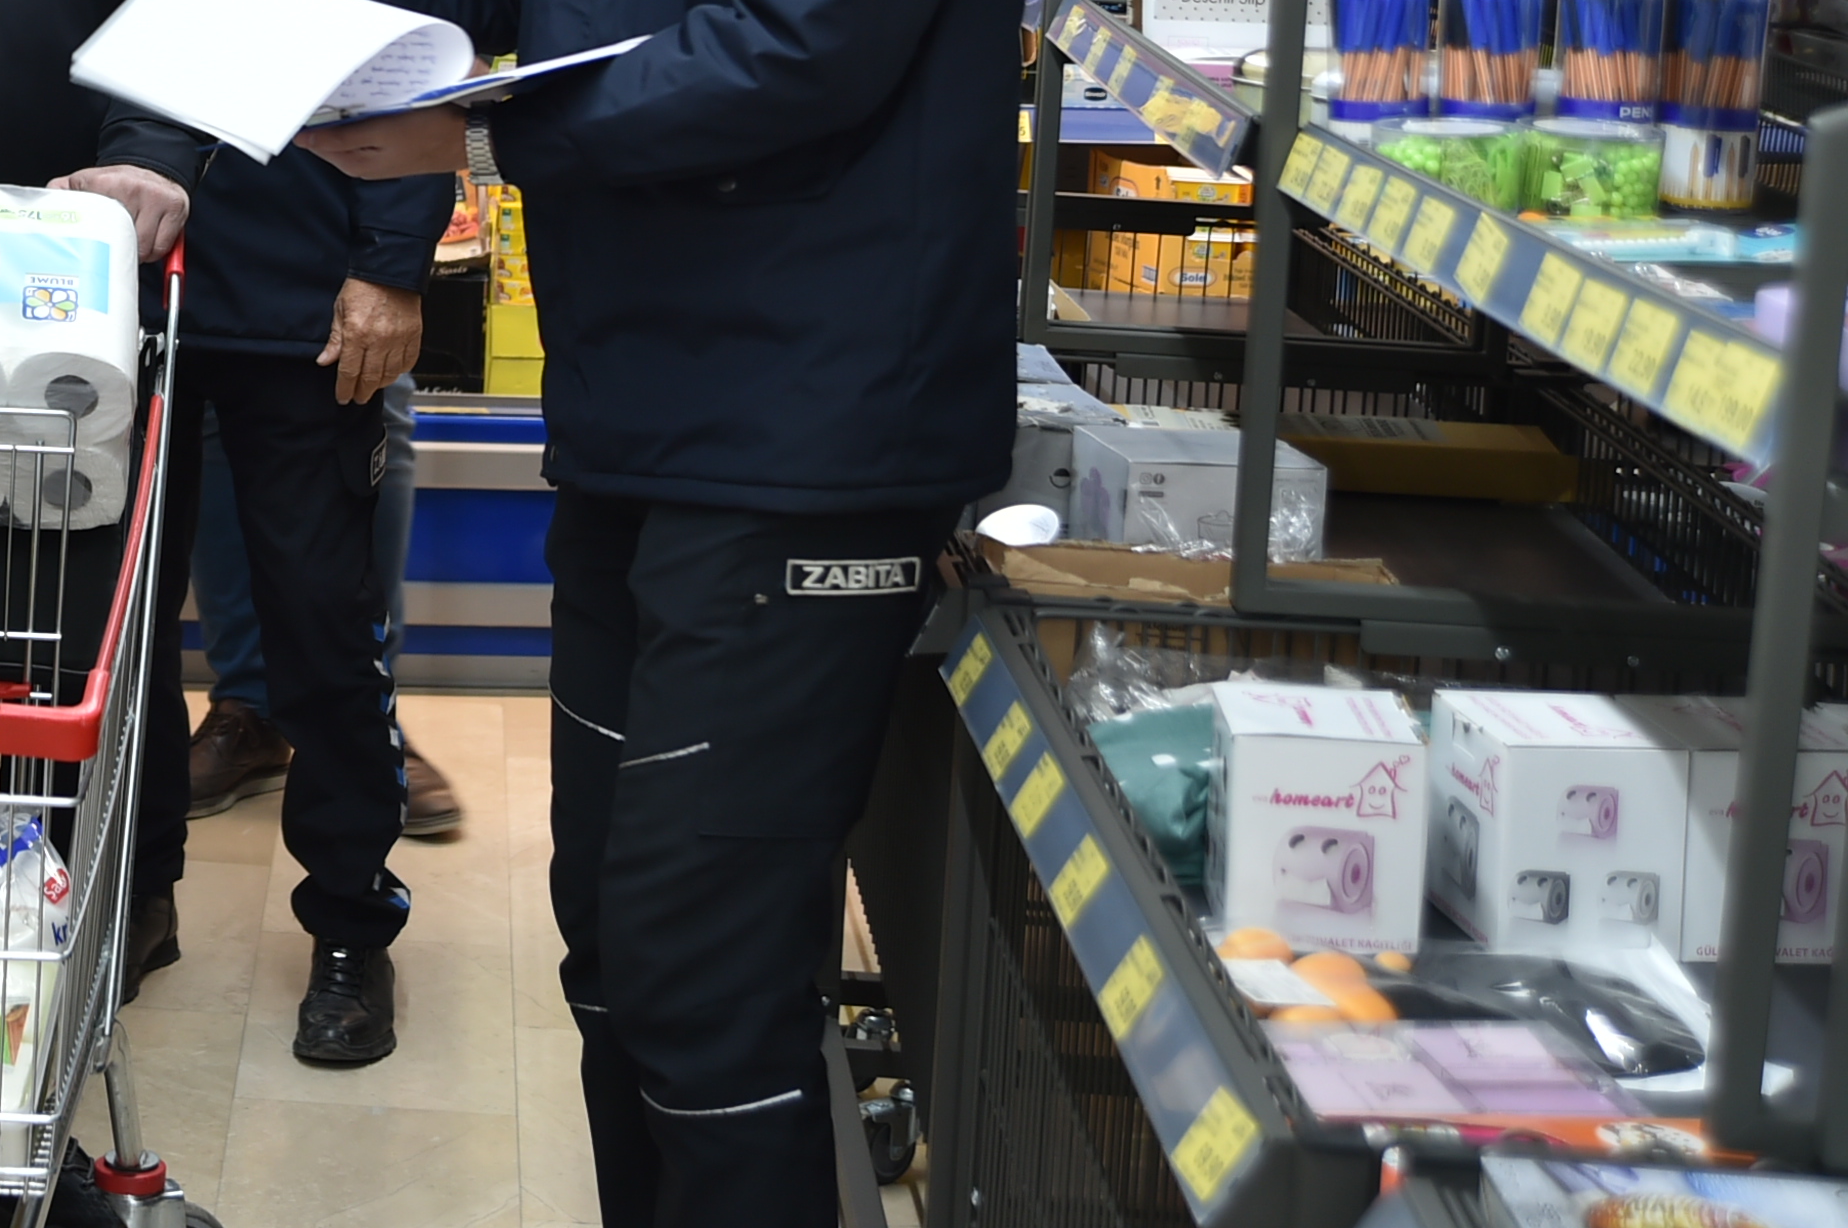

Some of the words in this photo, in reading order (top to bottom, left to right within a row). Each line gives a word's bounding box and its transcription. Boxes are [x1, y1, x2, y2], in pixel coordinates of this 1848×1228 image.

[29, 276, 75, 287] BLUME
[801, 564, 905, 590] ZABITA
[1270, 787, 1356, 810] homeart
[1775, 946, 1809, 958] VALET
